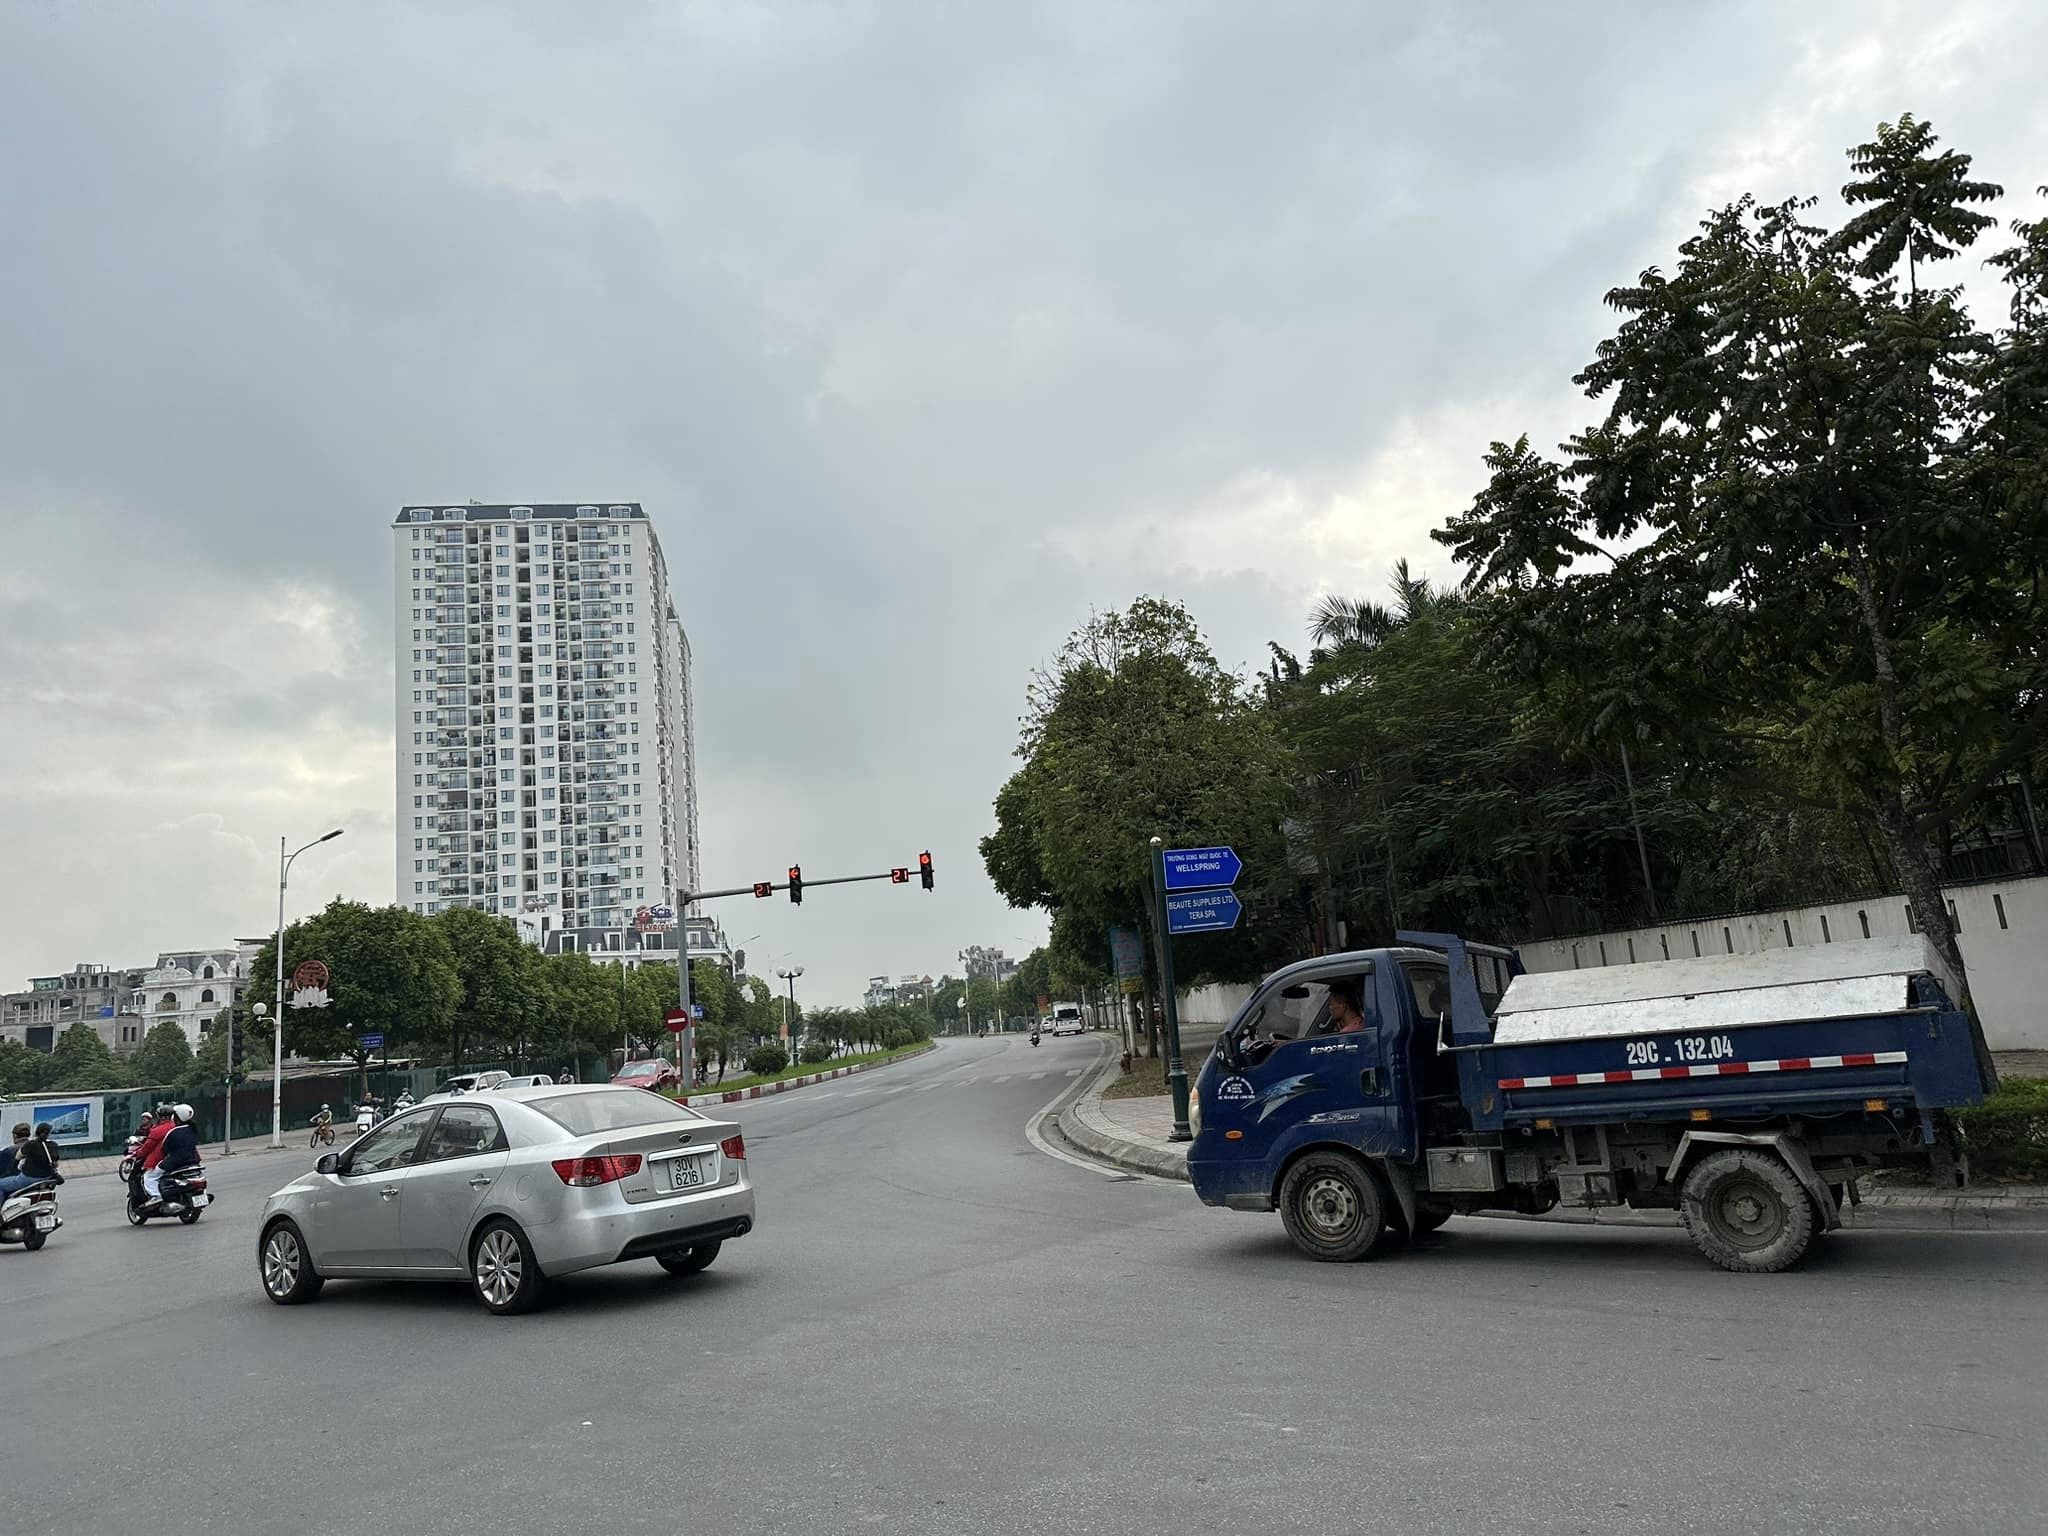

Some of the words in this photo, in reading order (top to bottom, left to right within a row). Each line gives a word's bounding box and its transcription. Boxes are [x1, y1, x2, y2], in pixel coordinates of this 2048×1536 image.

[1176, 862, 1220, 872] WELLSPRING
[893, 870, 908, 882] 21
[754, 884, 771, 896] 21
[1168, 900, 1192, 910] BEAUTE
[1193, 898, 1220, 907] SUPPLIES
[1222, 896, 1233, 904] LTD
[1189, 912, 1204, 920] TERA
[1204, 910, 1216, 918] SPA
[1626, 1041, 1659, 1064] 29C
[1674, 1036, 1734, 1060] 132.04
[675, 1158, 694, 1172] 30V
[676, 1170, 698, 1186] 6216
